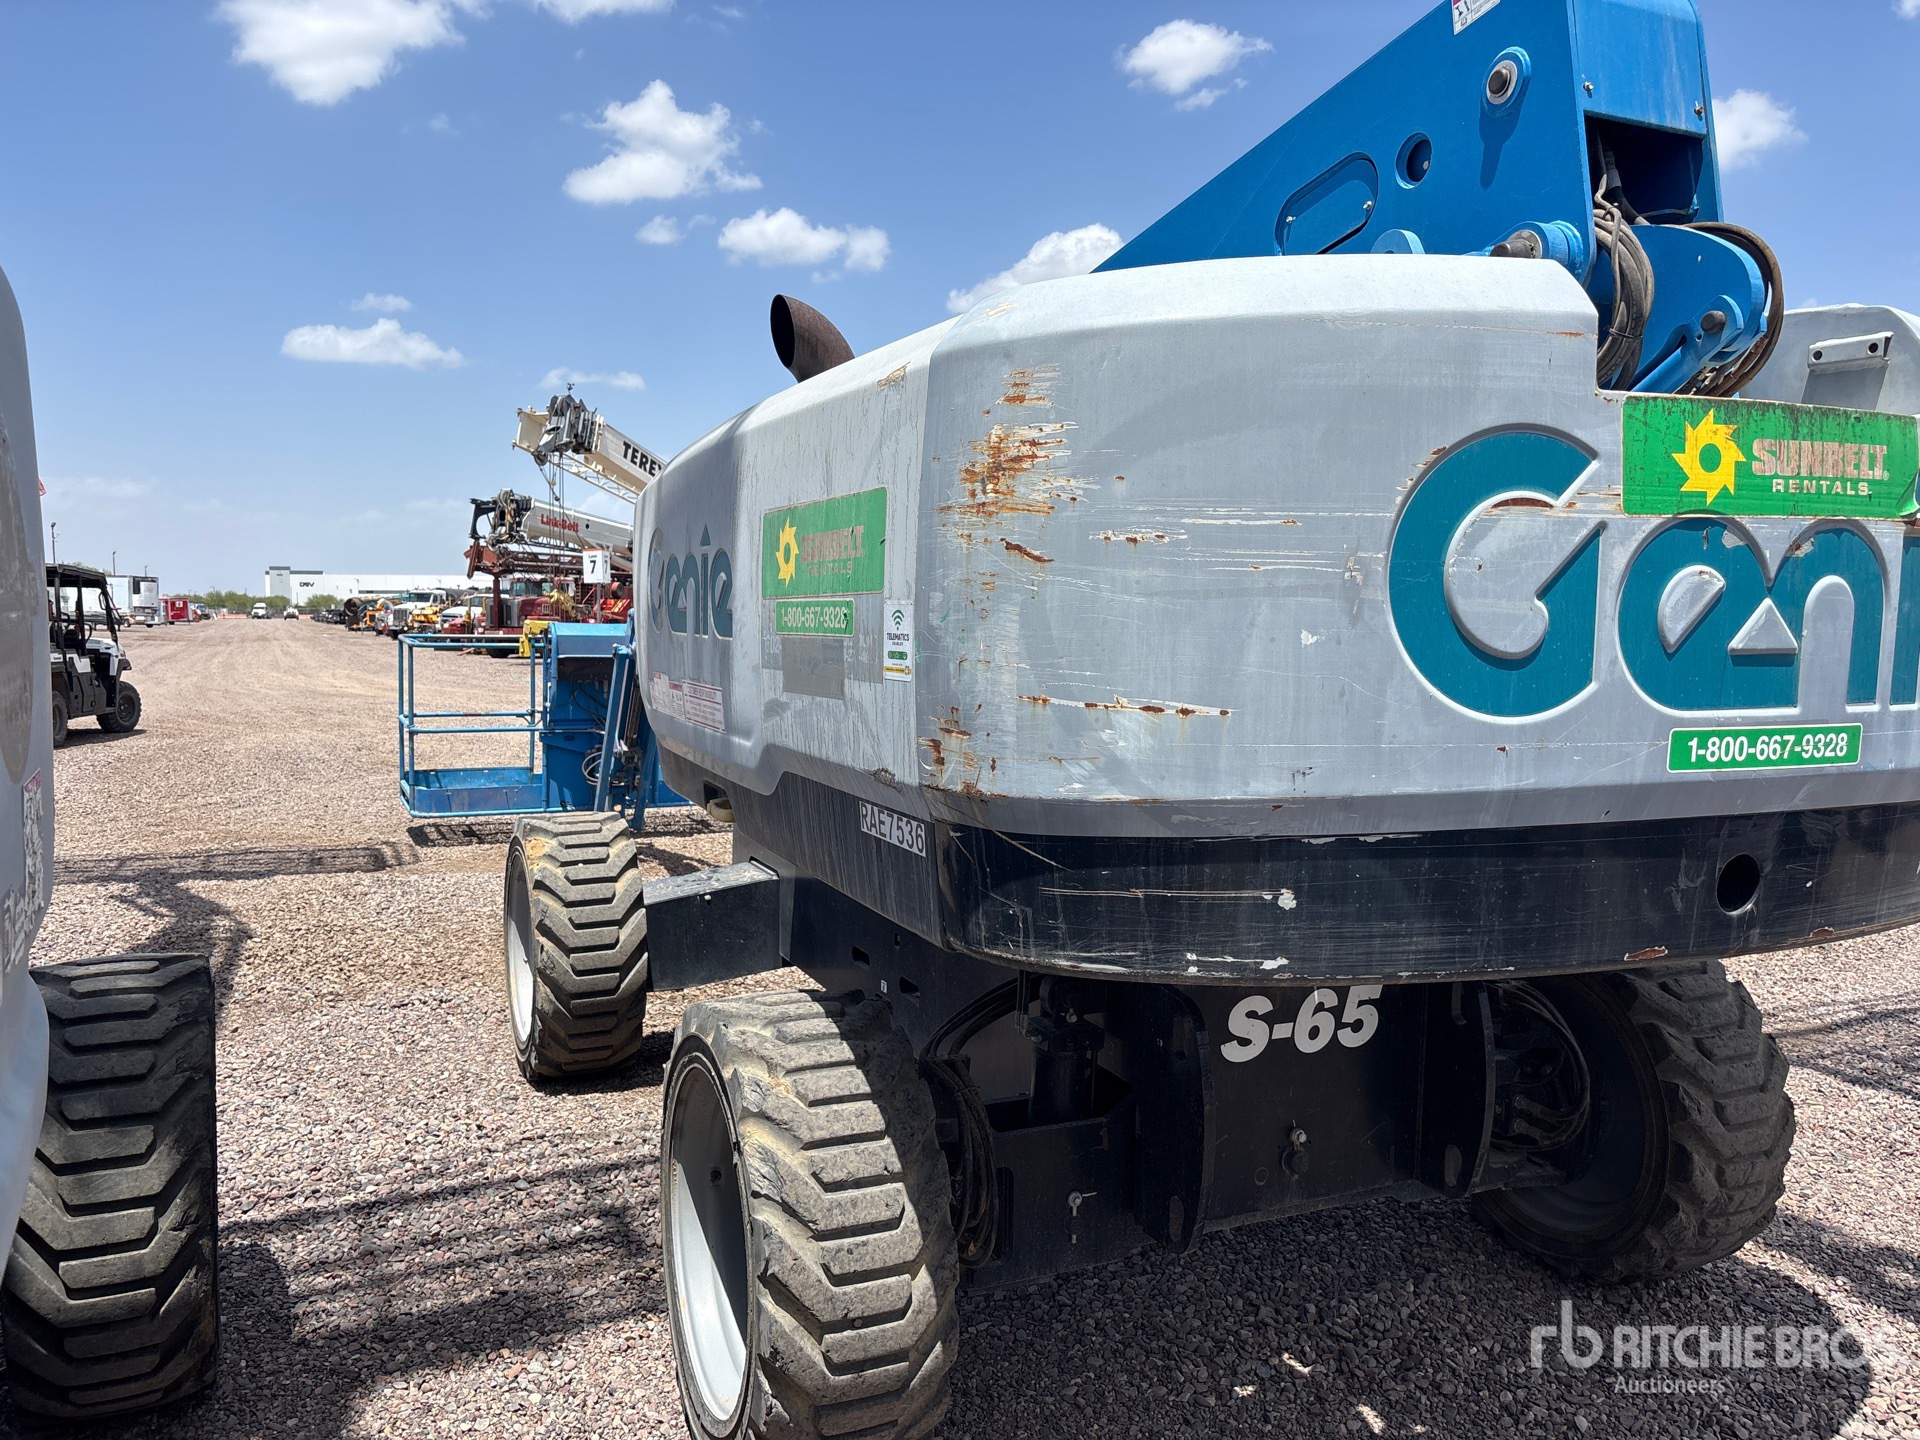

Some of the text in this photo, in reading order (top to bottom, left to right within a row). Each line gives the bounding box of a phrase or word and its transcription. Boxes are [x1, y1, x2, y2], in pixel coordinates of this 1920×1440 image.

[1752, 438, 1888, 480] SUNBELT
[1772, 479, 1868, 496] RENTALS
[540, 514, 579, 533] Link-Belt
[590, 560, 597, 574] 7
[808, 561, 853, 576] RENTALS
[781, 606, 847, 628] 1-800-667-9328
[886, 632, 910, 642] TELEMATICS
[1687, 732, 1849, 763] 1-800-667-9328
[860, 802, 925, 854] RAE7536
[1220, 984, 1383, 1063] S-65
